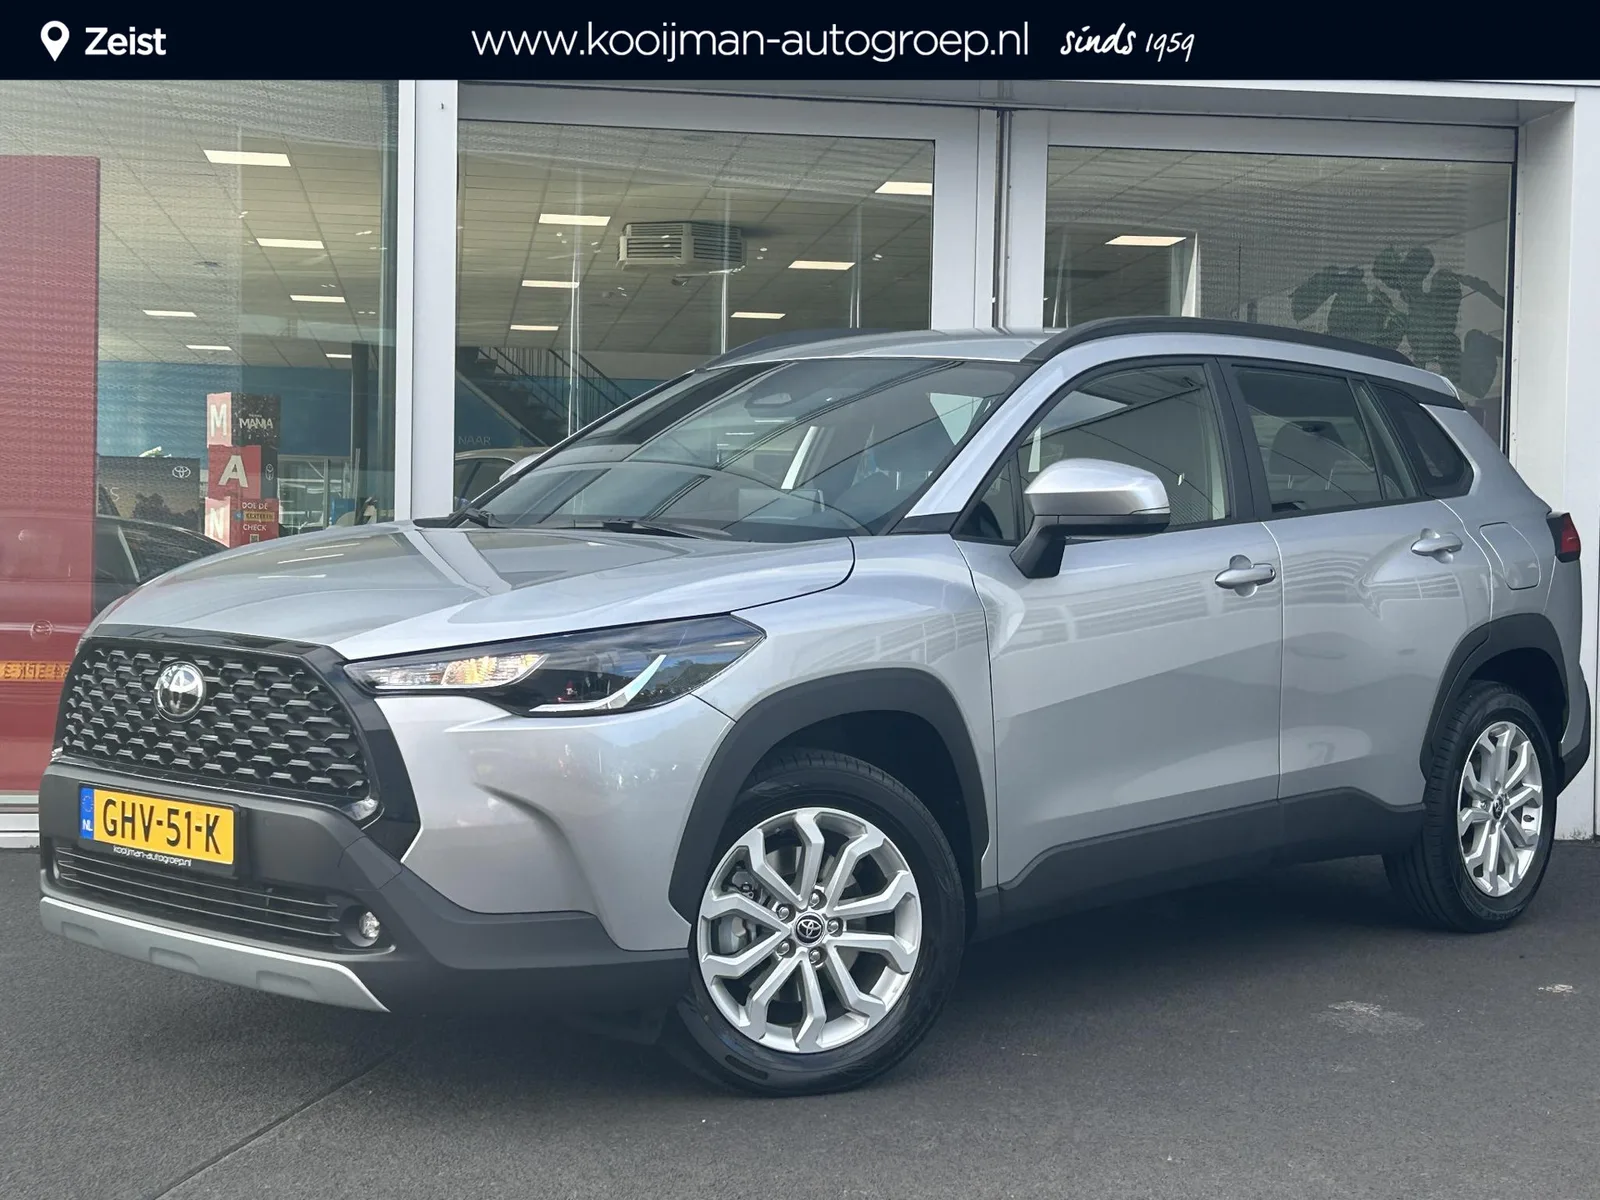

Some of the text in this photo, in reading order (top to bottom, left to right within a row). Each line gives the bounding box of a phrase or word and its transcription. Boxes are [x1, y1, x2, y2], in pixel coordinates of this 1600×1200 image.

[239, 417, 273, 429] MANIA
[243, 523, 267, 531] CHECK
[82, 818, 93, 832] NL
[103, 798, 221, 855] GHV-51-K
